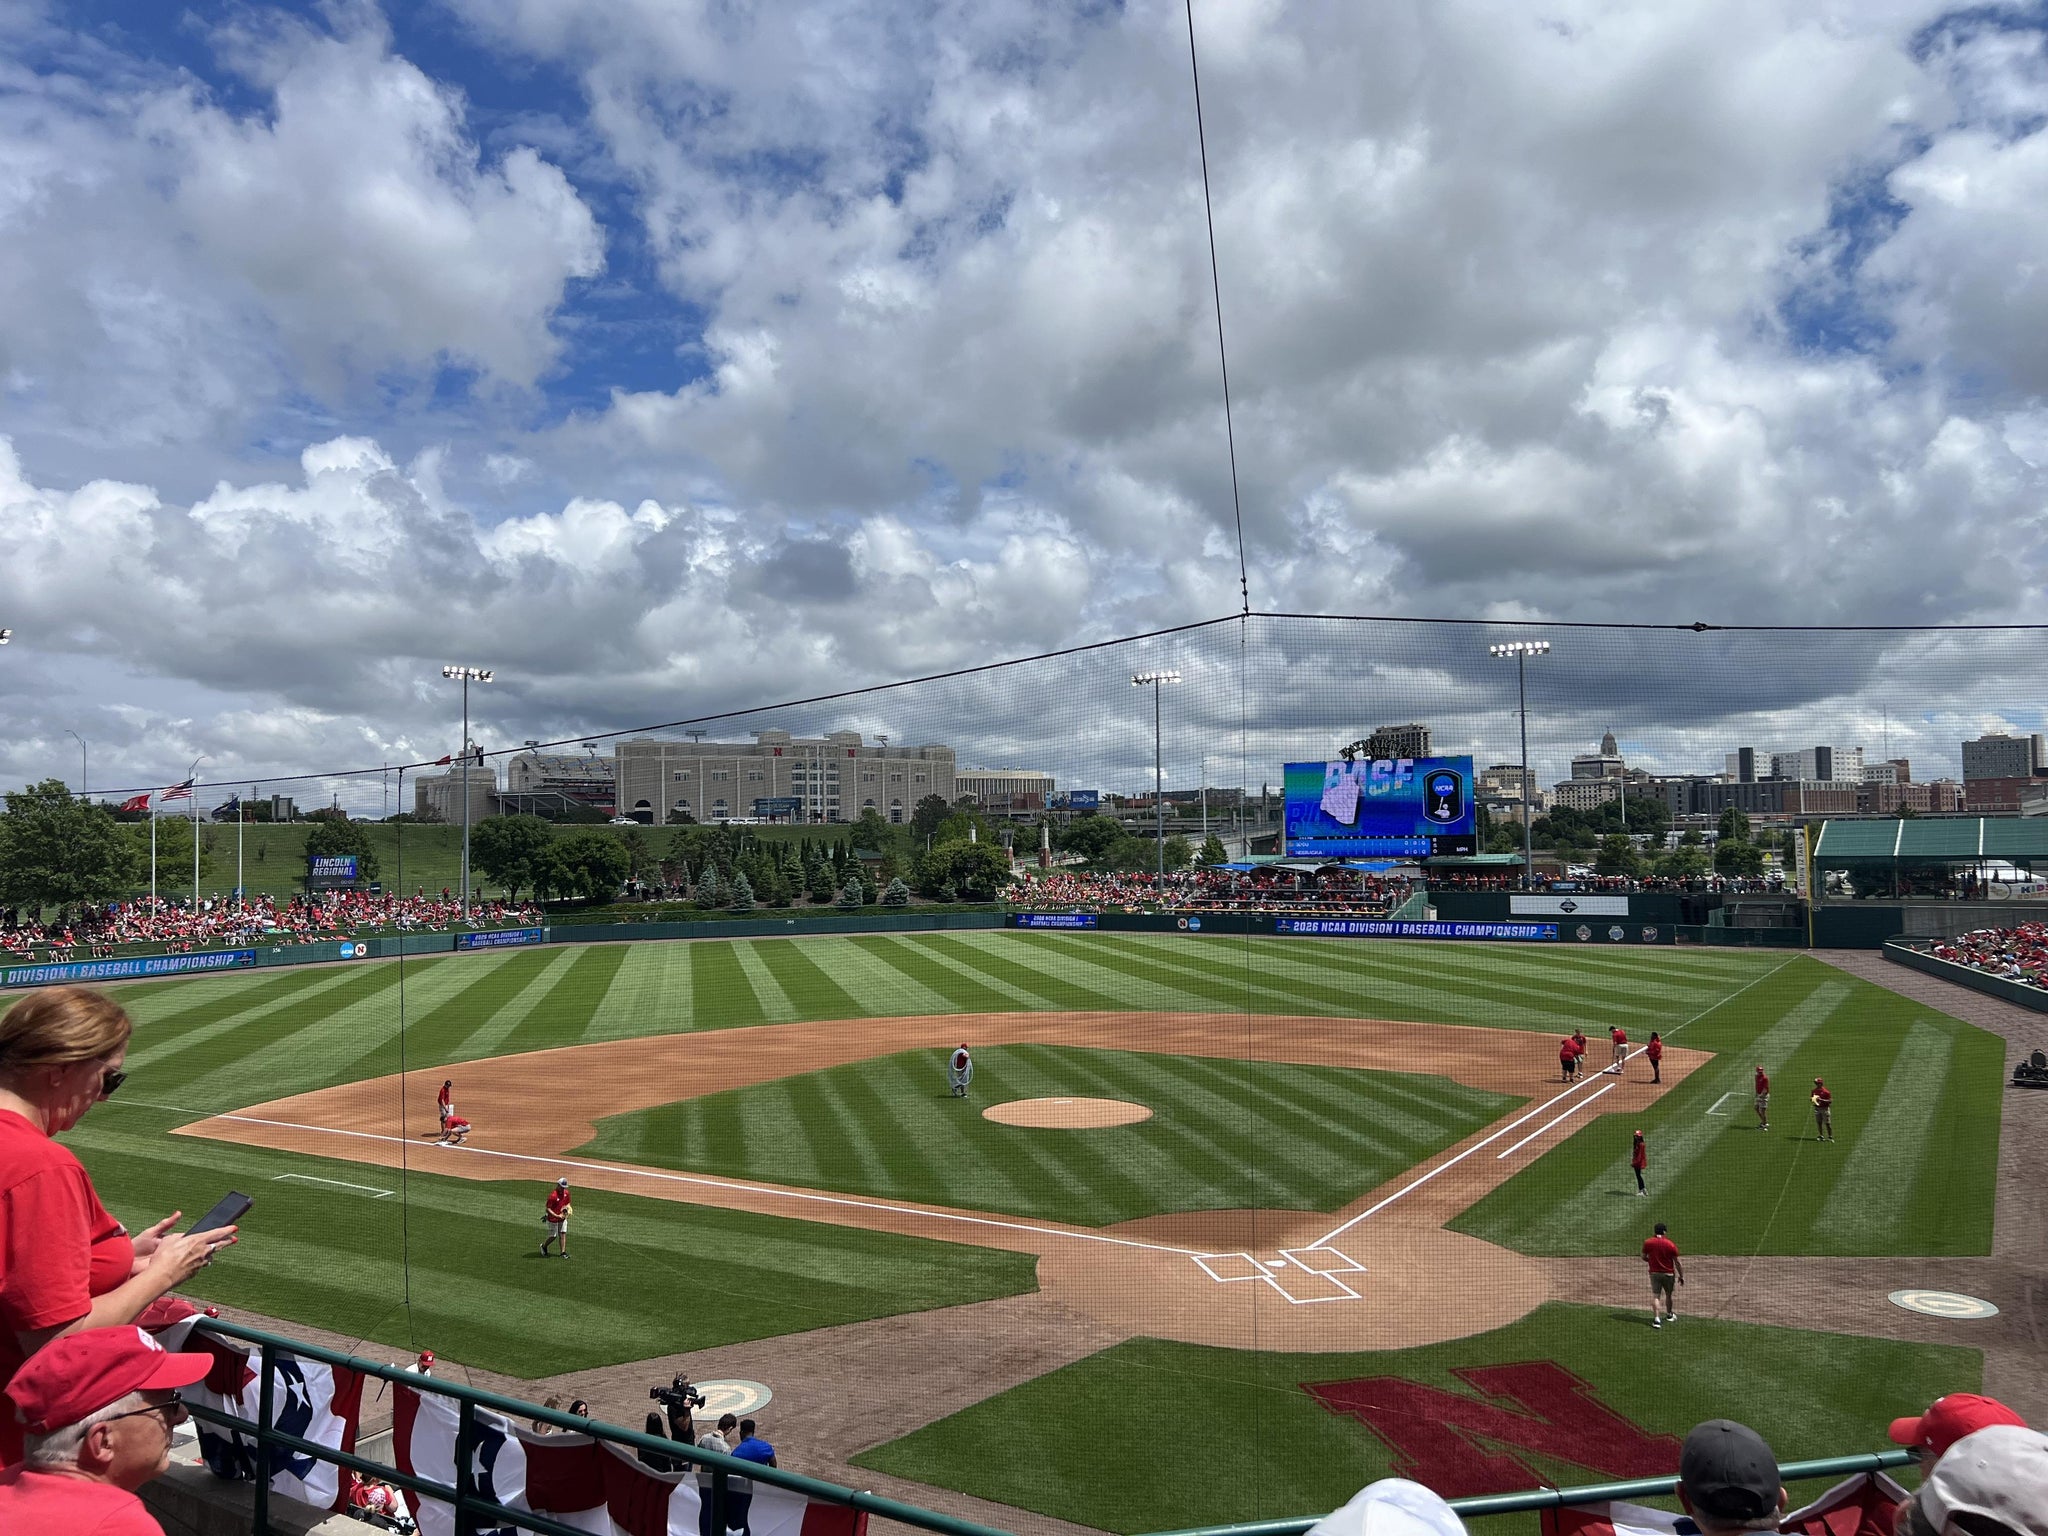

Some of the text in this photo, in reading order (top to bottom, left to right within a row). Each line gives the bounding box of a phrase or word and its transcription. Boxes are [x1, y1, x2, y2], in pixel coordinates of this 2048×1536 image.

[315, 858, 351, 867] LINCOLN
[312, 867, 353, 876] REGIONAL
[1293, 921, 1319, 932] 2026
[1321, 922, 1346, 932] NCAA
[1349, 922, 1393, 934] DIVISION
[1402, 924, 1451, 935] BASEBALL
[1455, 925, 1537, 937] CHAMPIONSHIP
[7, 967, 72, 983] DIVISION
[80, 963, 141, 978] BASEBALL
[145, 954, 234, 974] CHAMPIONSHIP
[1299, 1360, 1683, 1499] N
